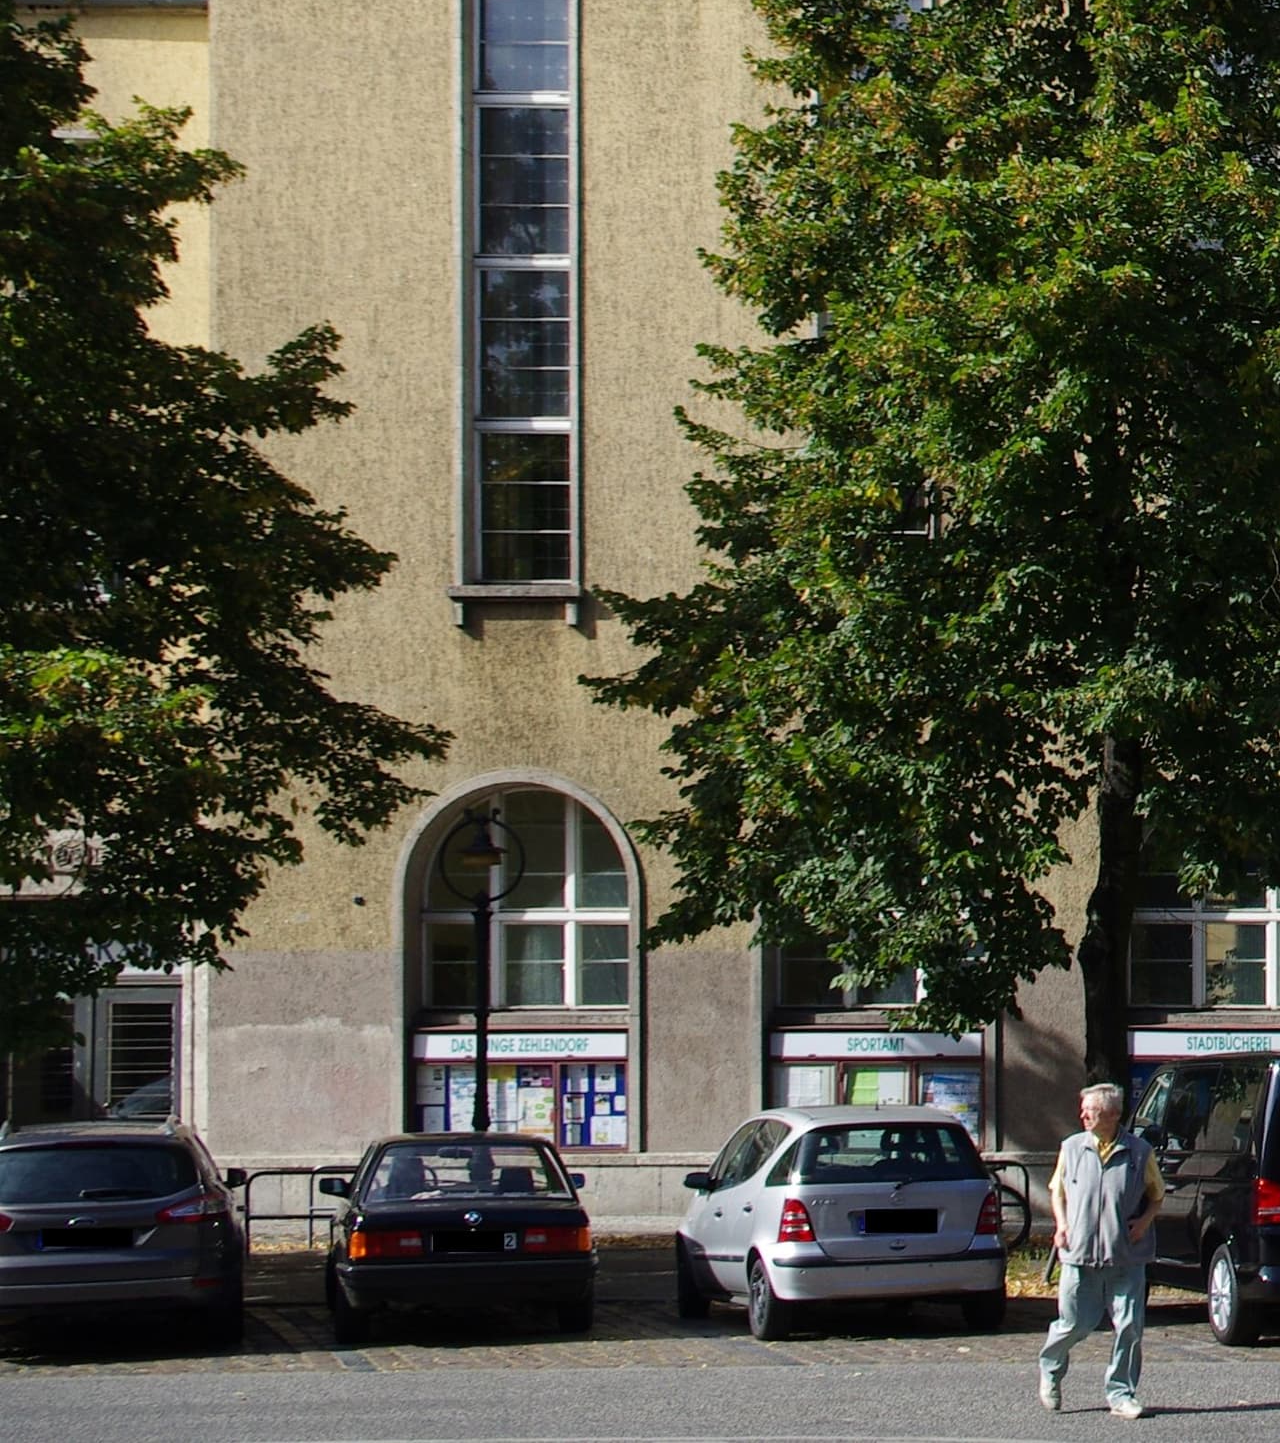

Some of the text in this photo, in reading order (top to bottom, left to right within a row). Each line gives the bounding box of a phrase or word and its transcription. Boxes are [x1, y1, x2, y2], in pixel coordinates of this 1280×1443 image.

[451, 1037, 590, 1053] DAS NGE ZEHLENDORF
[847, 1037, 905, 1052] SPORTAMT
[1186, 1033, 1272, 1052] STADTBÜCHEREI
